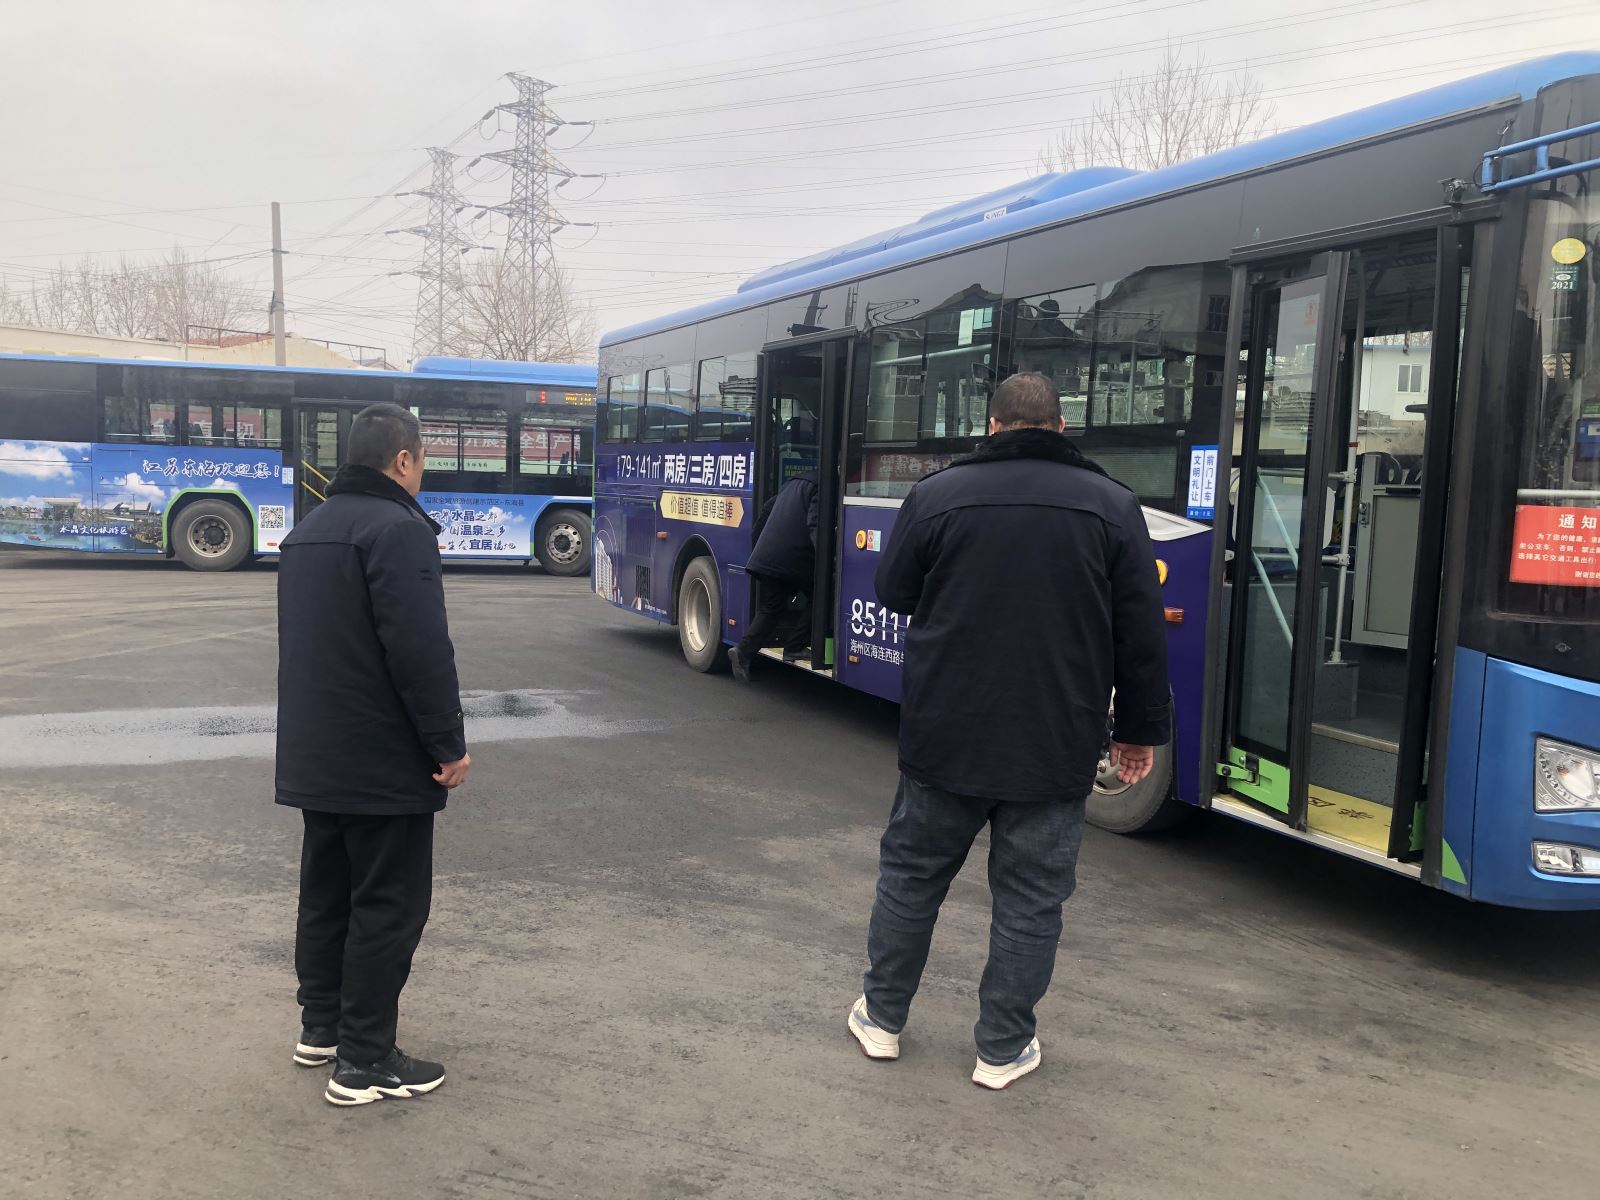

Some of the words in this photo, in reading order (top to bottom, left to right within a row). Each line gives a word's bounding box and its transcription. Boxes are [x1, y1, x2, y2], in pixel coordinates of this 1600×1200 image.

[1551, 281, 1574, 290] 2021
[664, 453, 746, 488] 两房/三房/四房
[1191, 455, 1202, 502] 文明礼让
[1204, 455, 1215, 503] 前门上车
[1558, 514, 1597, 529] 通知
[851, 598, 912, 644] 8511
